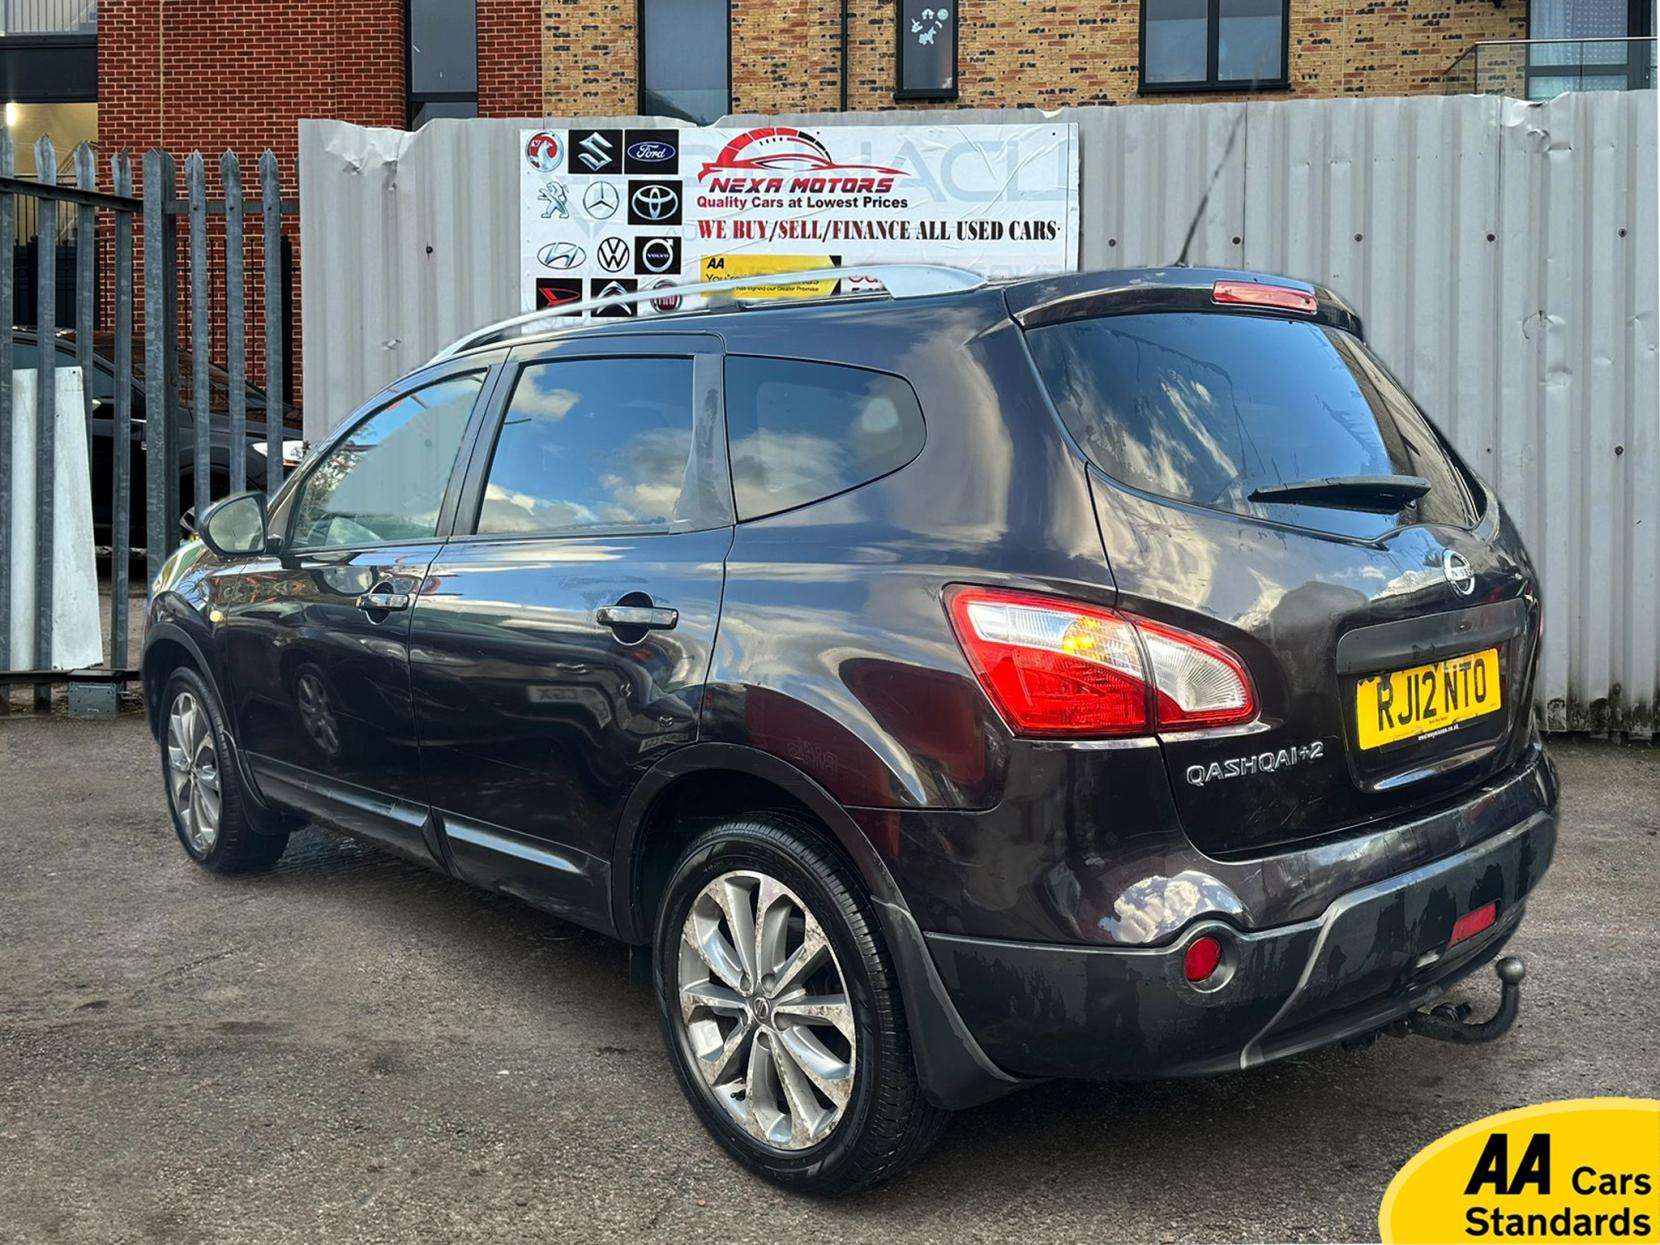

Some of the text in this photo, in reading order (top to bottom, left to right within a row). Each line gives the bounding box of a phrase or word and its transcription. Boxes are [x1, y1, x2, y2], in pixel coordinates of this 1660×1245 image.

[636, 144, 666, 159] Ford
[709, 178, 894, 193] NEXA MOTORS
[697, 197, 908, 208] Quality Cars at Lowest Prices
[697, 220, 727, 240] WE
[733, 220, 910, 242] BUY/SELL/FINANCE
[916, 221, 951, 240] ALL
[957, 221, 1003, 240] USED
[1009, 221, 1057, 240] CARS
[707, 257, 725, 269] AA
[1376, 658, 1486, 732] RJ12 NTO
[1186, 741, 1324, 786] QASHQAI+2
